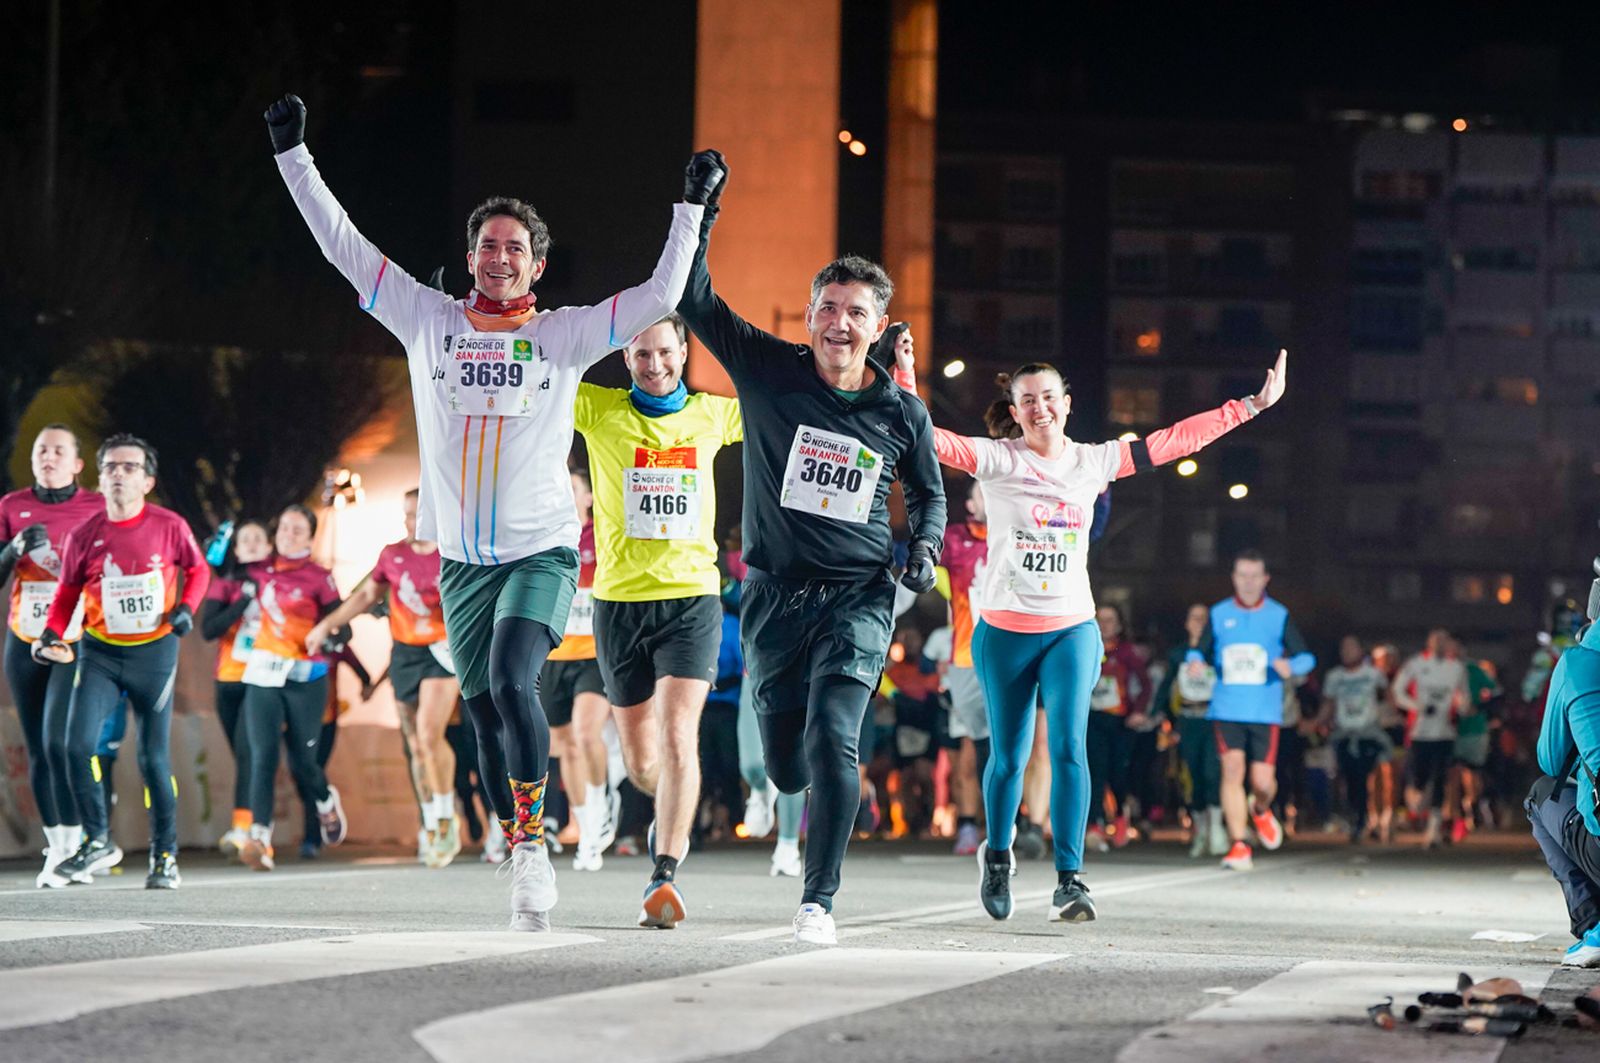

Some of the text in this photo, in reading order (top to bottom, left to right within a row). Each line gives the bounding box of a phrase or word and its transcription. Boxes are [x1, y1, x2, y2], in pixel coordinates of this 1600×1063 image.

[466, 341, 505, 350] NOCHE DE
[455, 351, 473, 361] SAN
[460, 362, 523, 387] 3639
[799, 445, 818, 457] SAN
[811, 439, 840, 450] NOCHE
[840, 445, 851, 454] DE
[641, 476, 665, 484] NOCHE
[800, 458, 863, 493] 3640
[639, 494, 688, 515] 4166
[1015, 542, 1031, 550] SAN
[1022, 552, 1067, 573] 4210
[118, 595, 154, 614] 1813
